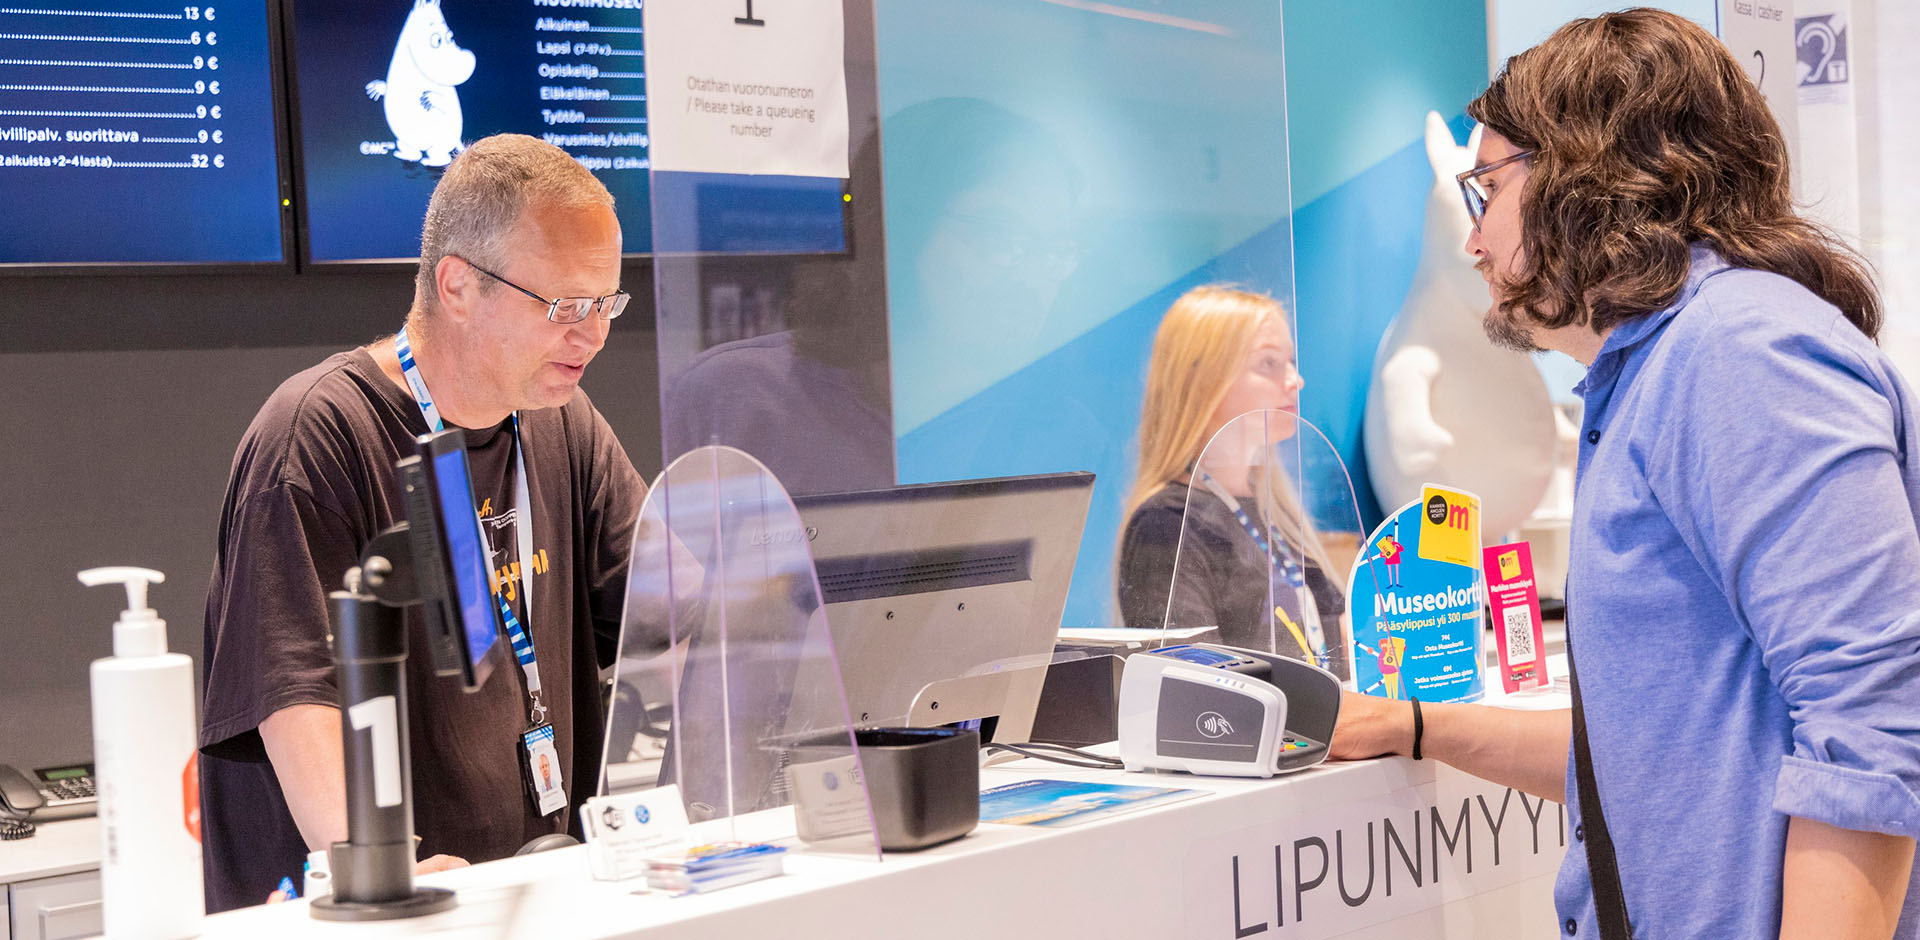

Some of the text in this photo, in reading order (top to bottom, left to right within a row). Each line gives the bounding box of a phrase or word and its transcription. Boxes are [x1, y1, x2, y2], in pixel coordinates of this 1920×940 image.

[184, 7, 216, 21] 13 €
[535, 17, 590, 32] Aikuinen
[190, 31, 217, 45] 6 €
[537, 41, 571, 56] Lapsi
[193, 56, 219, 70] 9 €
[538, 62, 599, 80] Opiskelija
[194, 81, 220, 95] 9 €
[540, 86, 610, 101] Eläkeläinen
[687, 76, 814, 99] Otathan vuoronumeron
[196, 105, 222, 119] 9 €
[541, 109, 586, 125] Työtön
[695, 98, 728, 114] Please
[731, 101, 753, 116] take
[756, 105, 763, 116] a
[766, 105, 816, 123] queueing
[65, 128, 139, 143] suorittava
[198, 130, 208, 143] 9
[211, 130, 223, 144] €
[730, 123, 773, 138] number
[191, 154, 209, 168] 32
[213, 154, 225, 168] €
[1449, 504, 1469, 532] m
[751, 525, 819, 546] Lenovo
[1376, 615, 1436, 633] Pääsylippusi
[1437, 613, 1447, 628] yli
[1447, 611, 1461, 624] 300
[348, 695, 402, 807] 1
